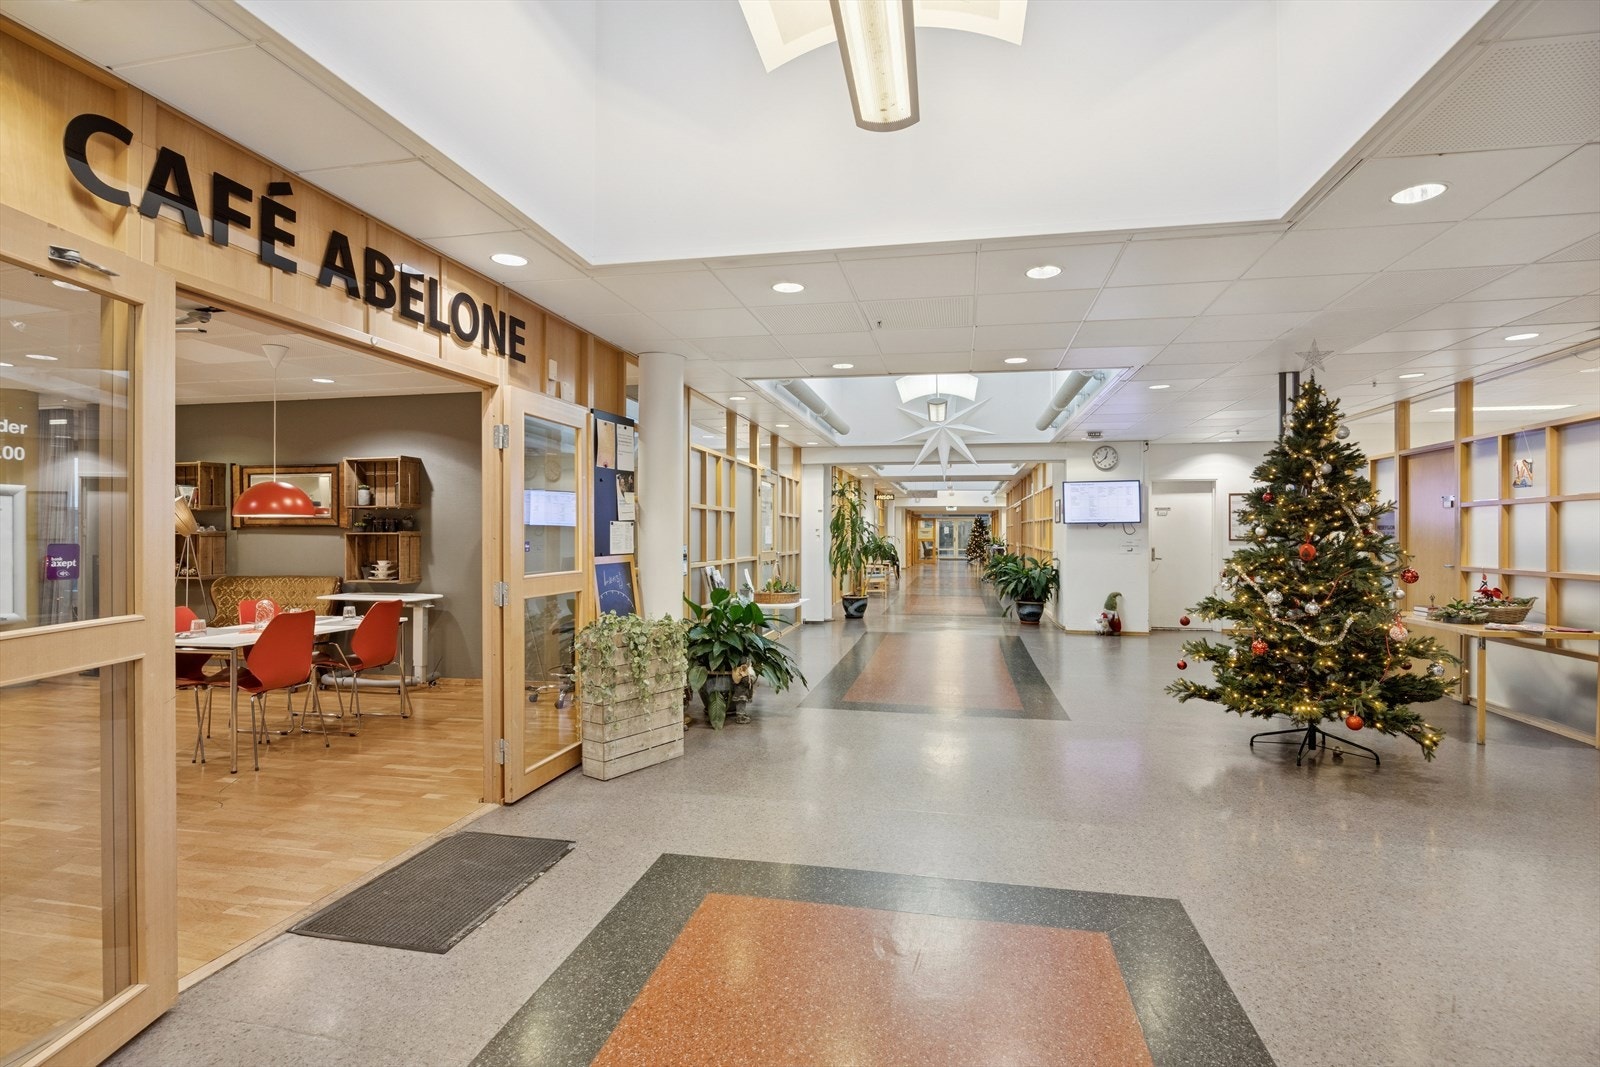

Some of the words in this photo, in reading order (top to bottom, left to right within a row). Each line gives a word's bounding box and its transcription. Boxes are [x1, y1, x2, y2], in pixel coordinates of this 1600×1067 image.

[63, 113, 297, 274] CAFÉ
[319, 230, 526, 364] ABELONE
[51, 559, 77, 569] axept
